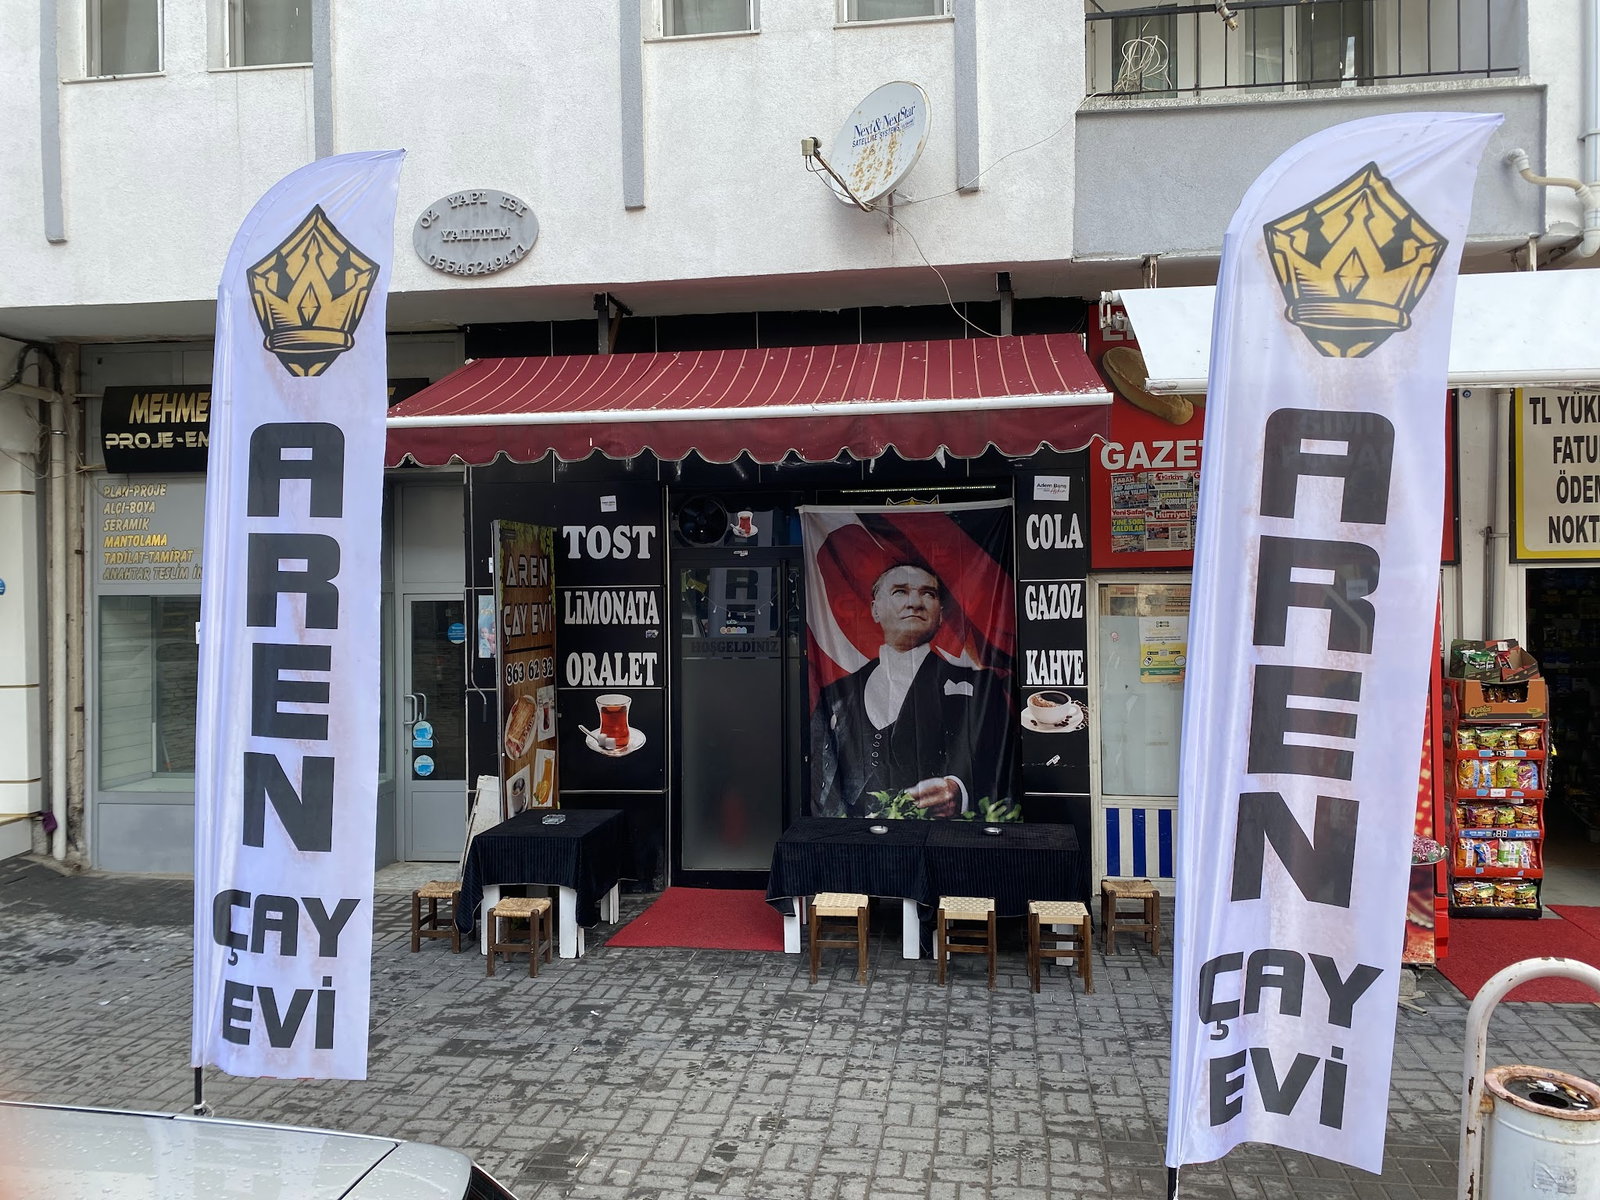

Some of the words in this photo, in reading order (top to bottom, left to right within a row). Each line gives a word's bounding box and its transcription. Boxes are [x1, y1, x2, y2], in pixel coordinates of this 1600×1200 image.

[1529, 397, 1552, 425] TL
[1557, 391, 1600, 425] YÜK
[1100, 439, 1204, 471] GAZE
[1553, 435, 1600, 464] FATU
[103, 483, 167, 498] PLAN-PROJE
[103, 501, 156, 517] ALÇI-BOYA
[103, 514, 150, 531] SERAMİK
[1155, 510, 1190, 519] Hürriyet
[104, 534, 168, 547] MANTOLAMA
[562, 525, 657, 560] TOST
[1025, 512, 1084, 550] COLA
[1549, 515, 1600, 543] NOKT
[103, 567, 151, 581] ANAHTAR
[152, 563, 189, 580] TESLİM
[104, 547, 194, 565] TADİLAT-TAMİRAT
[505, 553, 549, 588] AREN
[503, 604, 528, 645] ÇAY
[530, 594, 553, 636] EVİ
[1024, 583, 1083, 621] GAZOZ
[243, 421, 345, 853] AREN
[505, 661, 525, 687] 863
[527, 658, 540, 682] 62
[541, 656, 554, 681] 32
[565, 652, 658, 687] ORALET
[1025, 649, 1085, 686] KAHVE
[1230, 407, 1396, 909] AREN
[212, 889, 361, 966] ÇAY
[1199, 948, 1385, 1041] ÇAY
[221, 975, 337, 1050] EVİ
[1209, 1045, 1349, 1131] EVİ
